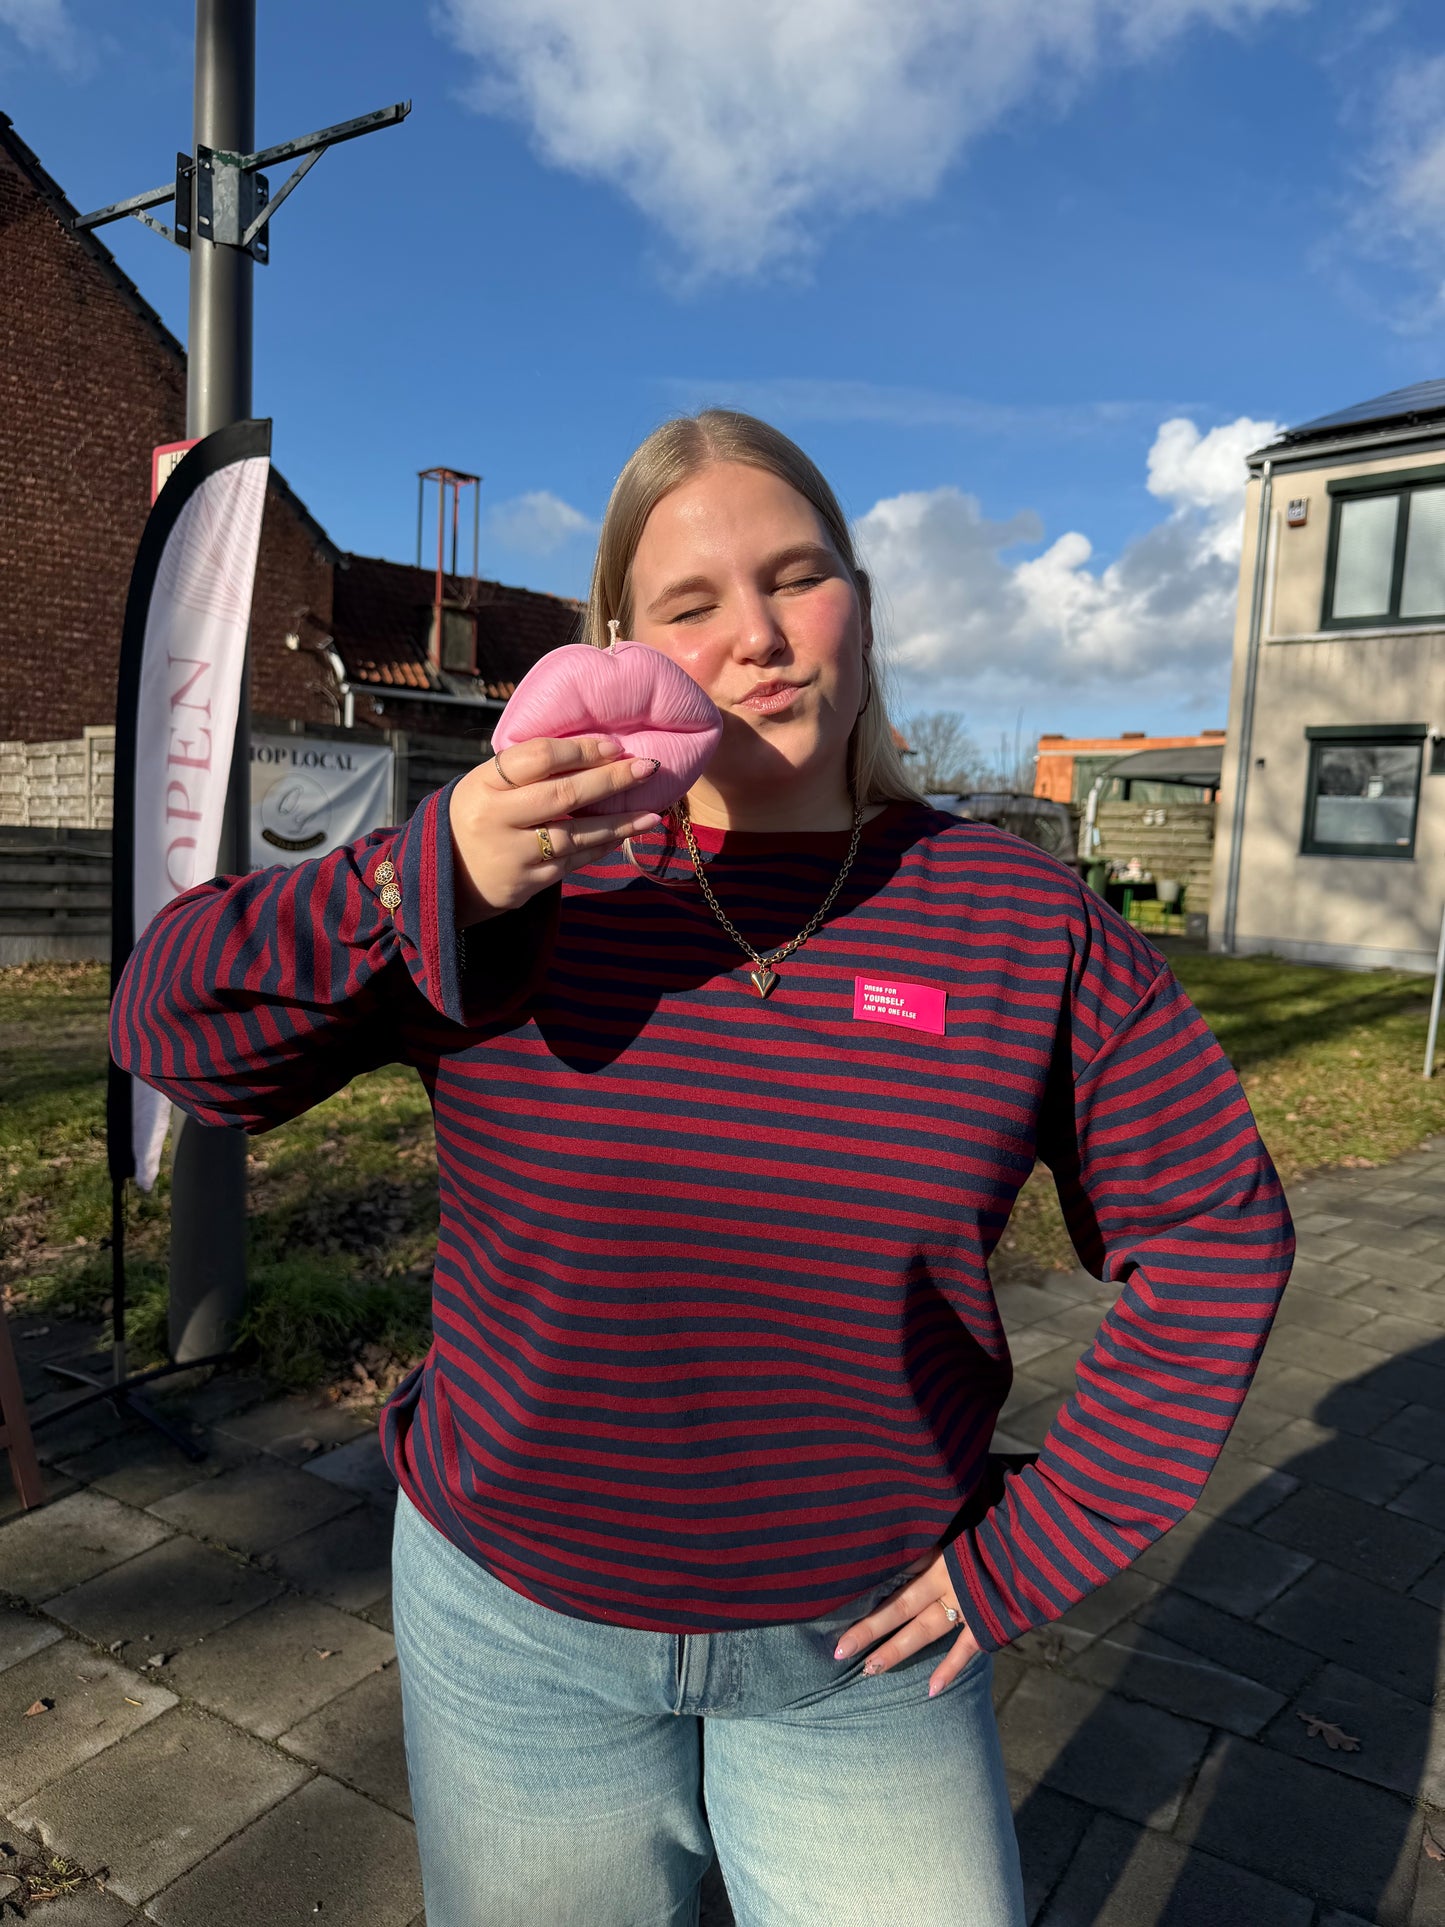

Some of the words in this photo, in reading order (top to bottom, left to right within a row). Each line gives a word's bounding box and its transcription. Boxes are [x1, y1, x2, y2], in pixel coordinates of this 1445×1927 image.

[291, 749, 358, 772] LOCAL
[165, 649, 212, 894] OPEN
[864, 984, 883, 992] DRESS
[864, 994, 904, 1006] YOURSELF
[863, 1004, 876, 1012] AND
[902, 1011, 916, 1019] ELSE
